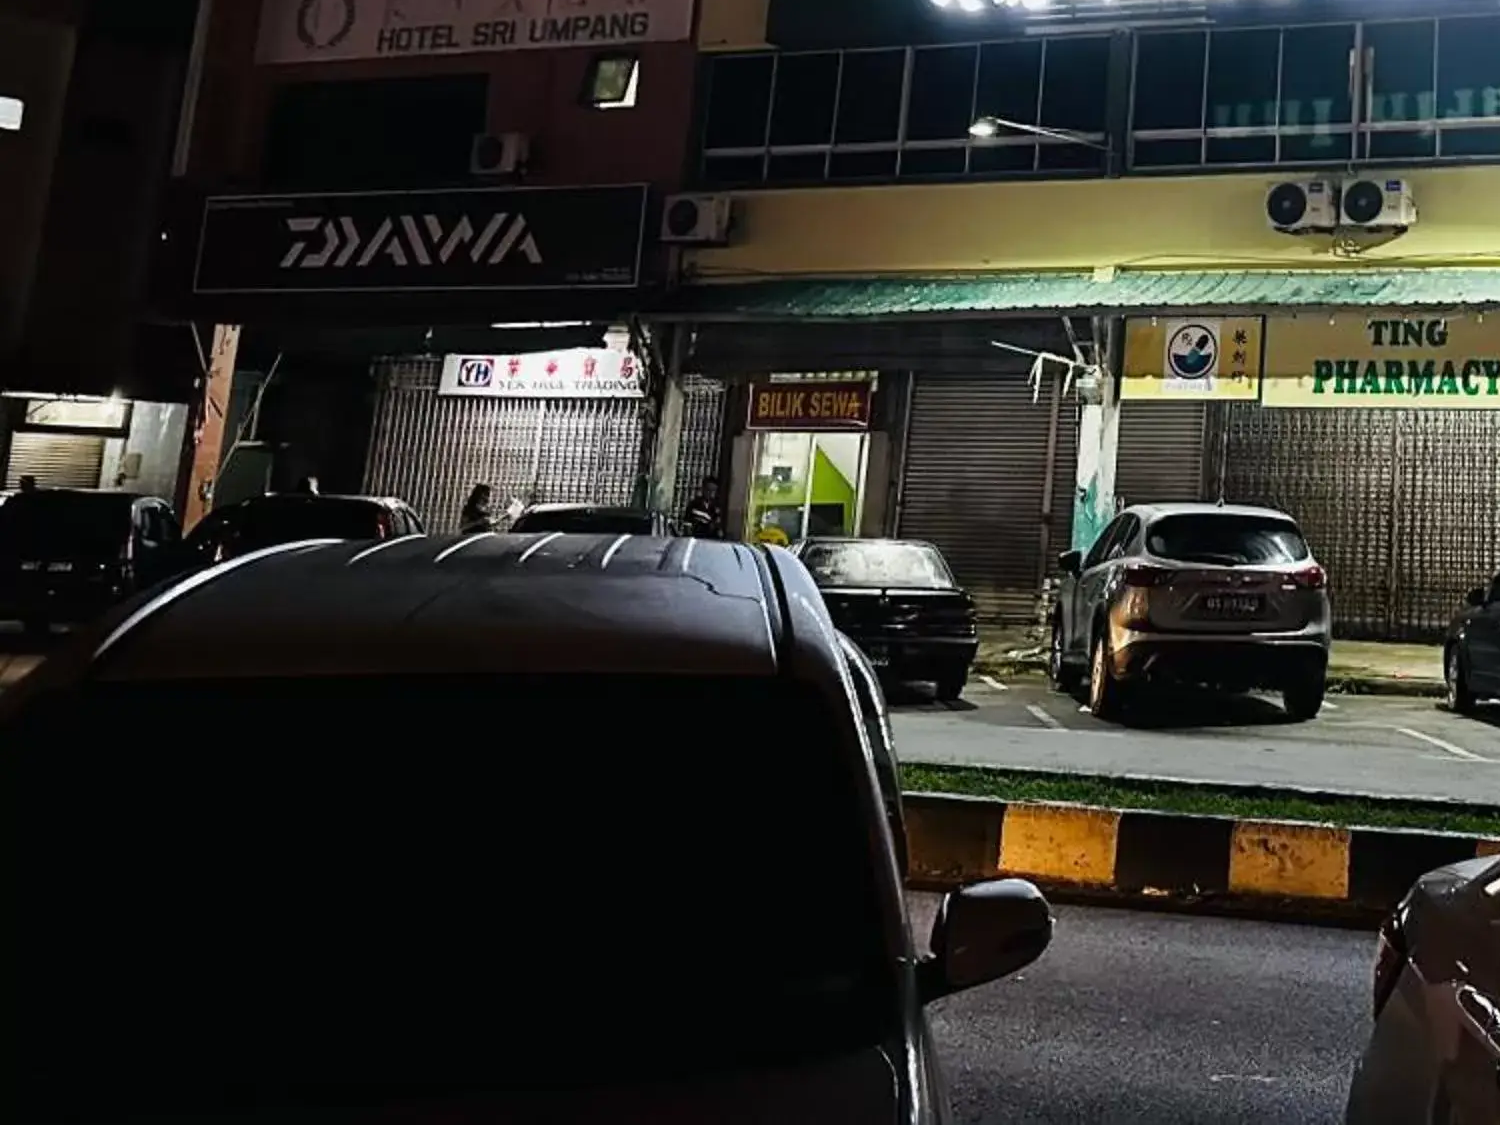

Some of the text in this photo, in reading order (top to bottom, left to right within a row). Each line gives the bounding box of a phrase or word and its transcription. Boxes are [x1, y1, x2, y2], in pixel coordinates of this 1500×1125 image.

[376, 12, 649, 54] HOTEL SRI UMPANG
[1367, 318, 1448, 348] TING
[464, 360, 491, 383] YH
[757, 390, 862, 419] BILIK SEWA
